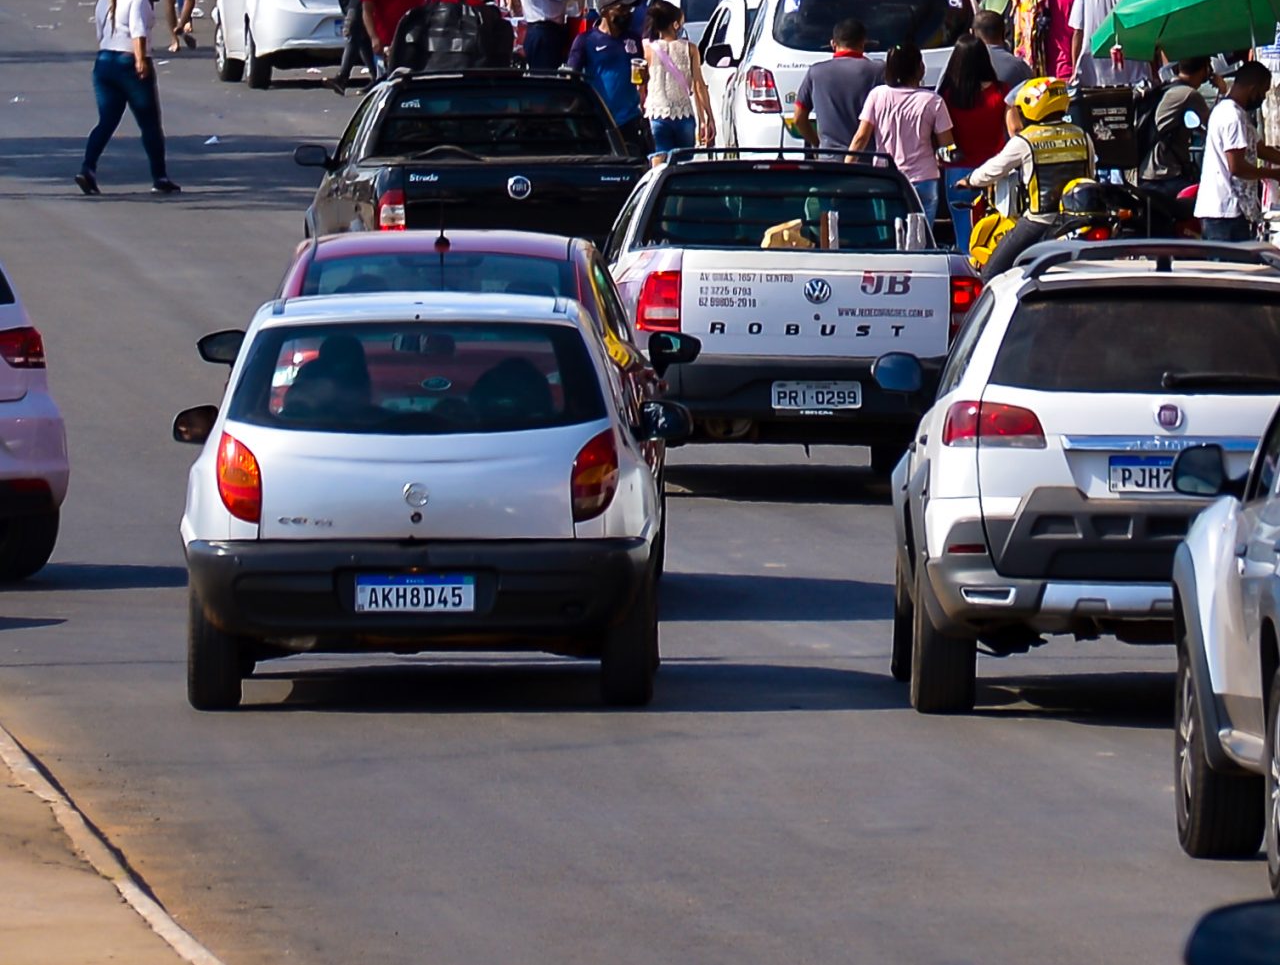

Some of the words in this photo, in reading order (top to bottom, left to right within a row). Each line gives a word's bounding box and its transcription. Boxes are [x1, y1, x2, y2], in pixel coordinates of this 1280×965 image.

[1032, 141, 1057, 150] MOTO
[1064, 137, 1087, 148] TAXI
[409, 174, 439, 182] Strada
[861, 271, 913, 296] JB
[709, 321, 905, 337] ROBUST
[368, 586, 463, 608] AKH8D45
